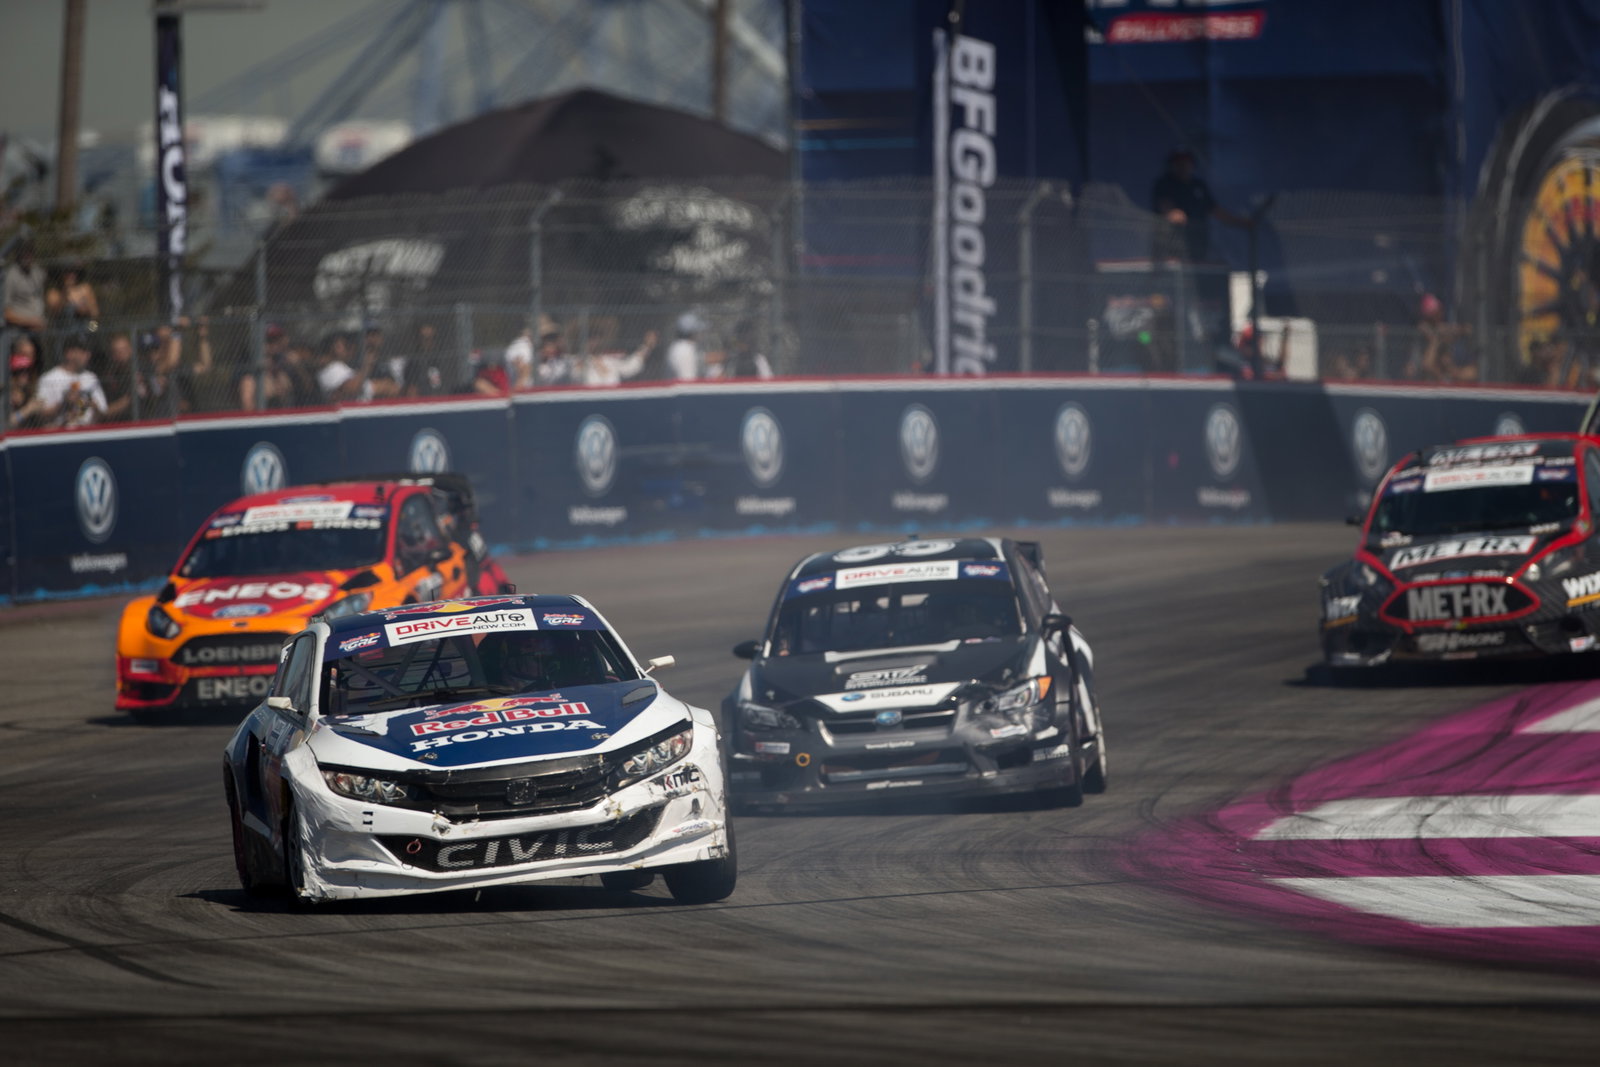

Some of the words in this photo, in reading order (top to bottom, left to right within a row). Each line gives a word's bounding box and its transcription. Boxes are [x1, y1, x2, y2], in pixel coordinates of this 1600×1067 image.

[174, 582, 332, 608] ENEOS
[871, 689, 933, 699] SUBARU
[410, 711, 502, 736] Red
[502, 702, 592, 723] Bull
[410, 719, 607, 753] HONDA
[437, 824, 614, 868] CIVIC
